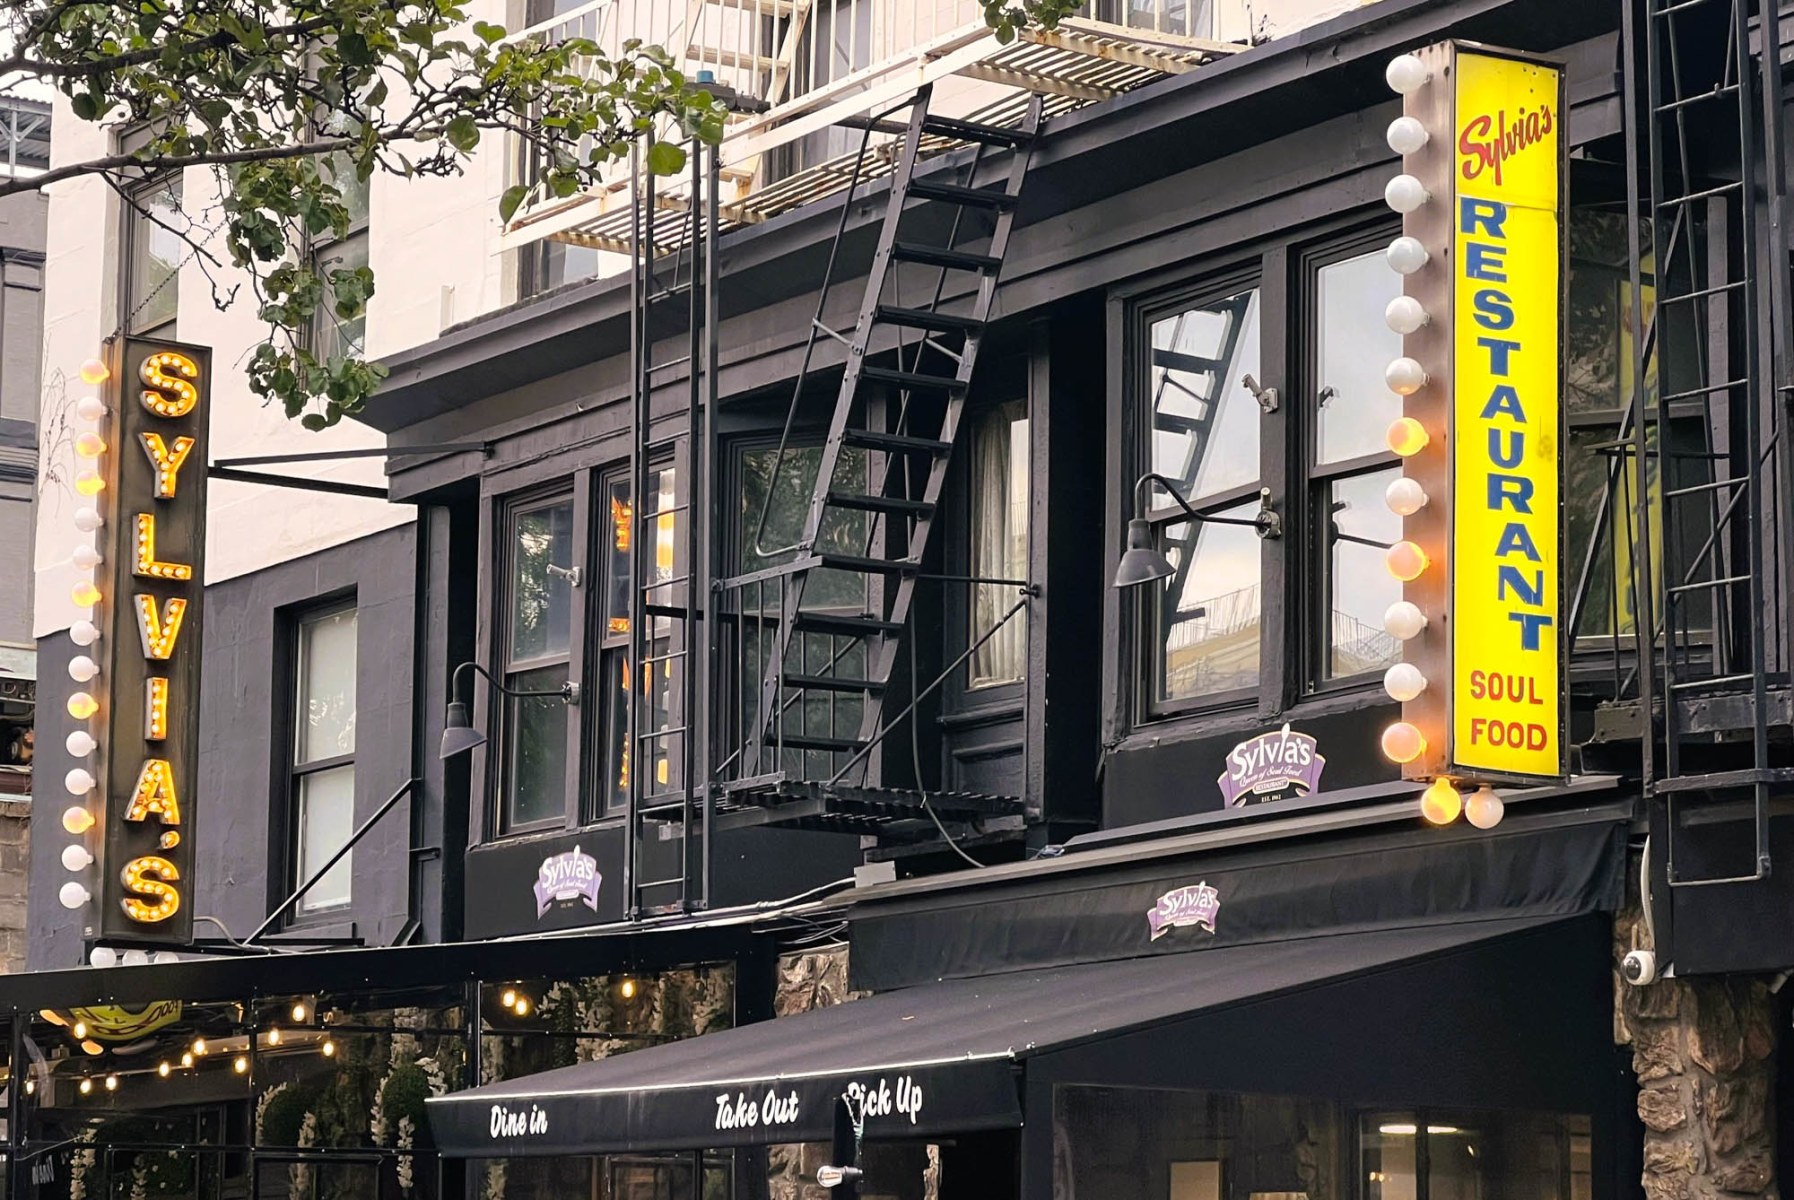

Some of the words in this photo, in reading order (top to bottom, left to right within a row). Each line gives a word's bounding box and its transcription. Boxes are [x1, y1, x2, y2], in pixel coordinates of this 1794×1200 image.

[1459, 105, 1552, 186] Sylvia's
[1460, 196, 1553, 651] RESTAURANT
[120, 351, 198, 923] SYLVIA'S
[1470, 670, 1544, 705] SOUL
[1231, 722, 1311, 781] Sylvia's
[1470, 718, 1548, 751] FOOD
[541, 844, 594, 888] Sylvia's
[1159, 881, 1214, 915] Sylvia's
[490, 1105, 527, 1138] Dine
[529, 1104, 548, 1135] in
[715, 1092, 758, 1130] Take
[762, 1089, 799, 1126] Out
[896, 1075, 923, 1124] Up
